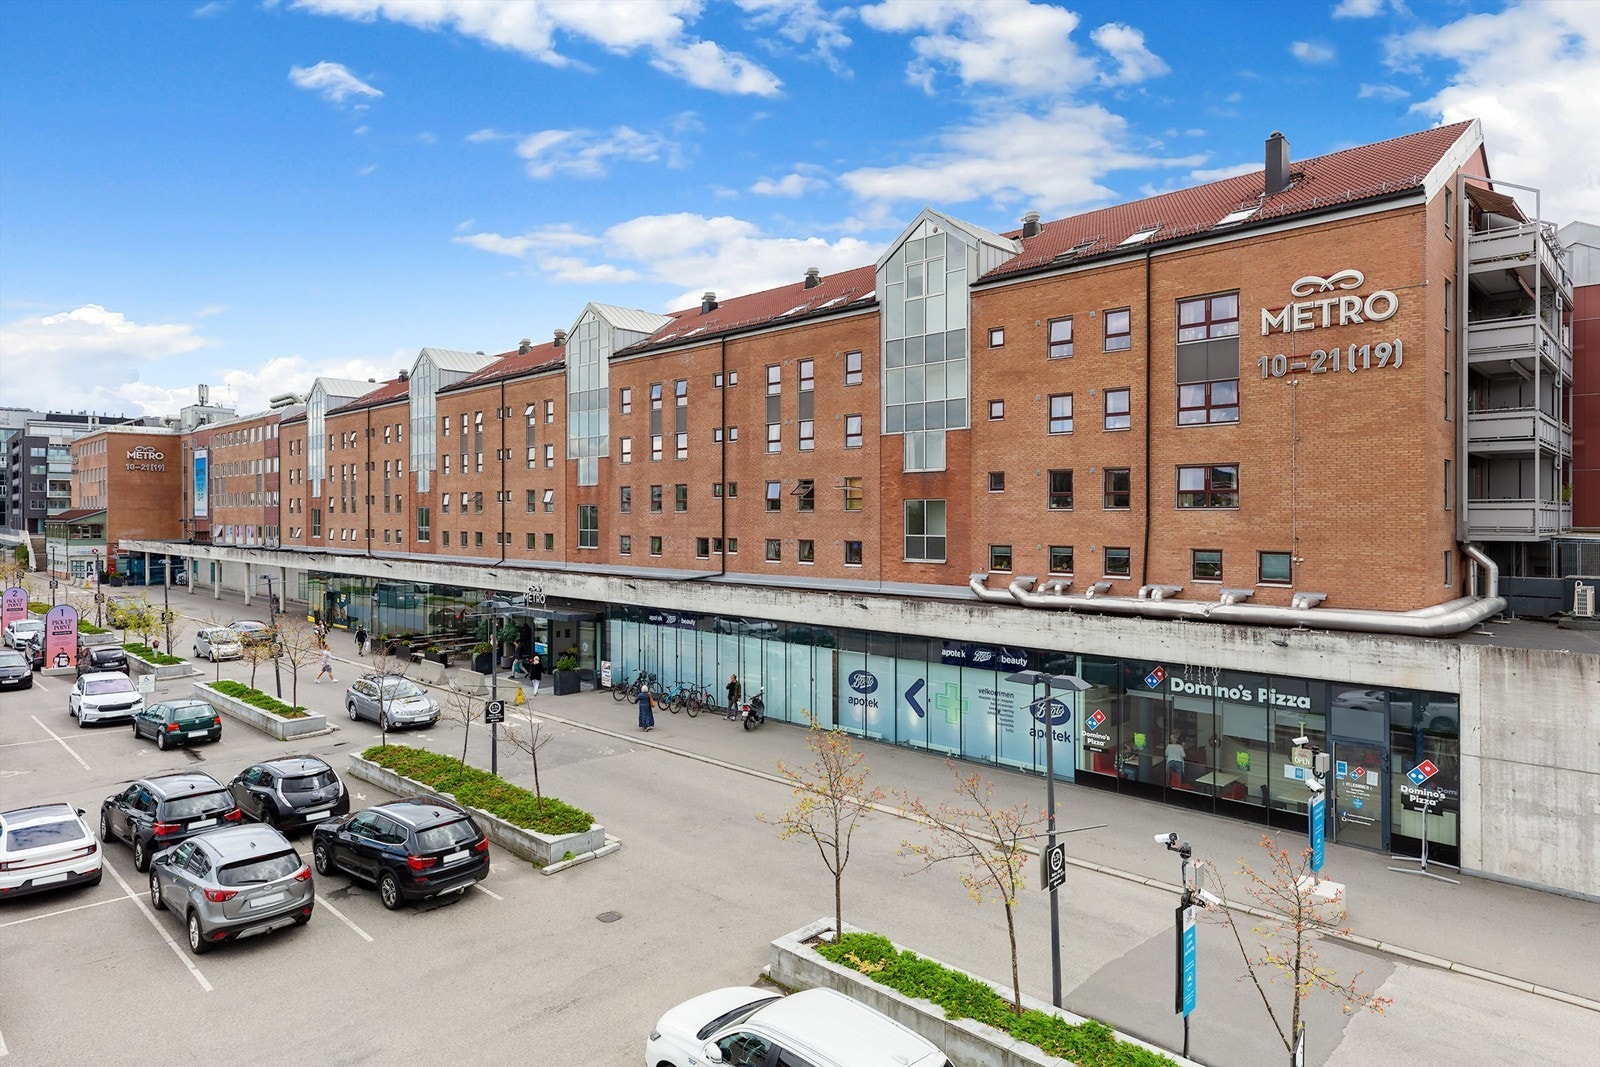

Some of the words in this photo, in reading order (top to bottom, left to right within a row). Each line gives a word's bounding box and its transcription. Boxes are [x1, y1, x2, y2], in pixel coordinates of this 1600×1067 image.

[1261, 290, 1399, 336] METRO
[126, 451, 164, 460] METRO
[523, 592, 546, 604] METRO
[941, 649, 966, 658] apotek
[1001, 655, 1028, 667] beauty
[1171, 677, 1252, 701] Domino's
[1258, 688, 1311, 709] Pizza
[1029, 727, 1071, 743] aptek
[1294, 757, 1311, 765] OPEN
[1400, 785, 1446, 799] Domino's
[1410, 794, 1437, 806] Pizza
